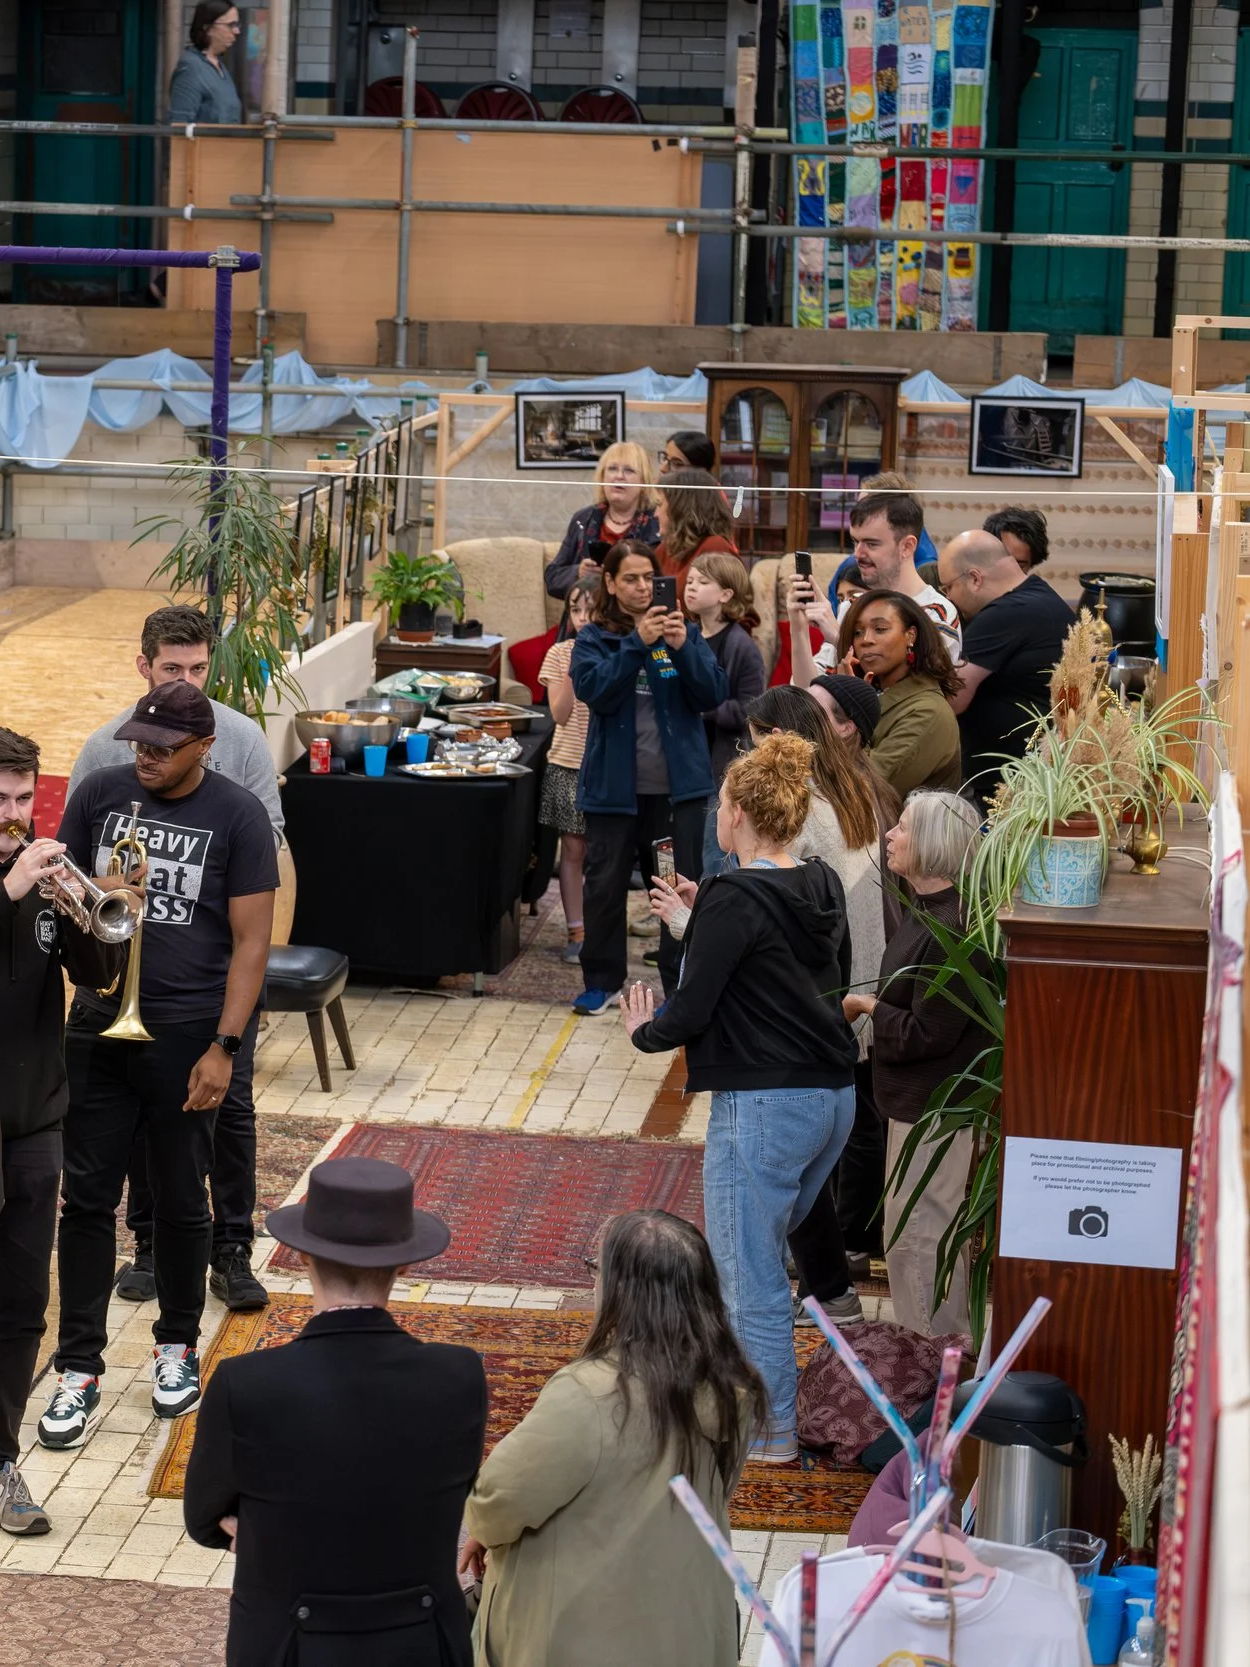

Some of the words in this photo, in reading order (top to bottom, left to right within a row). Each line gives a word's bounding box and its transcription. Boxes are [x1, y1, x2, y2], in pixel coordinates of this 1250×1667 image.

[112, 816, 199, 862] Heavy
[1031, 1160, 1047, 1168] place
[1056, 1162, 1091, 1170] promotional
[1075, 1156, 1132, 1166] filming/photography
[1138, 1160, 1157, 1168] taking
[1082, 1186, 1120, 1194] photographer
